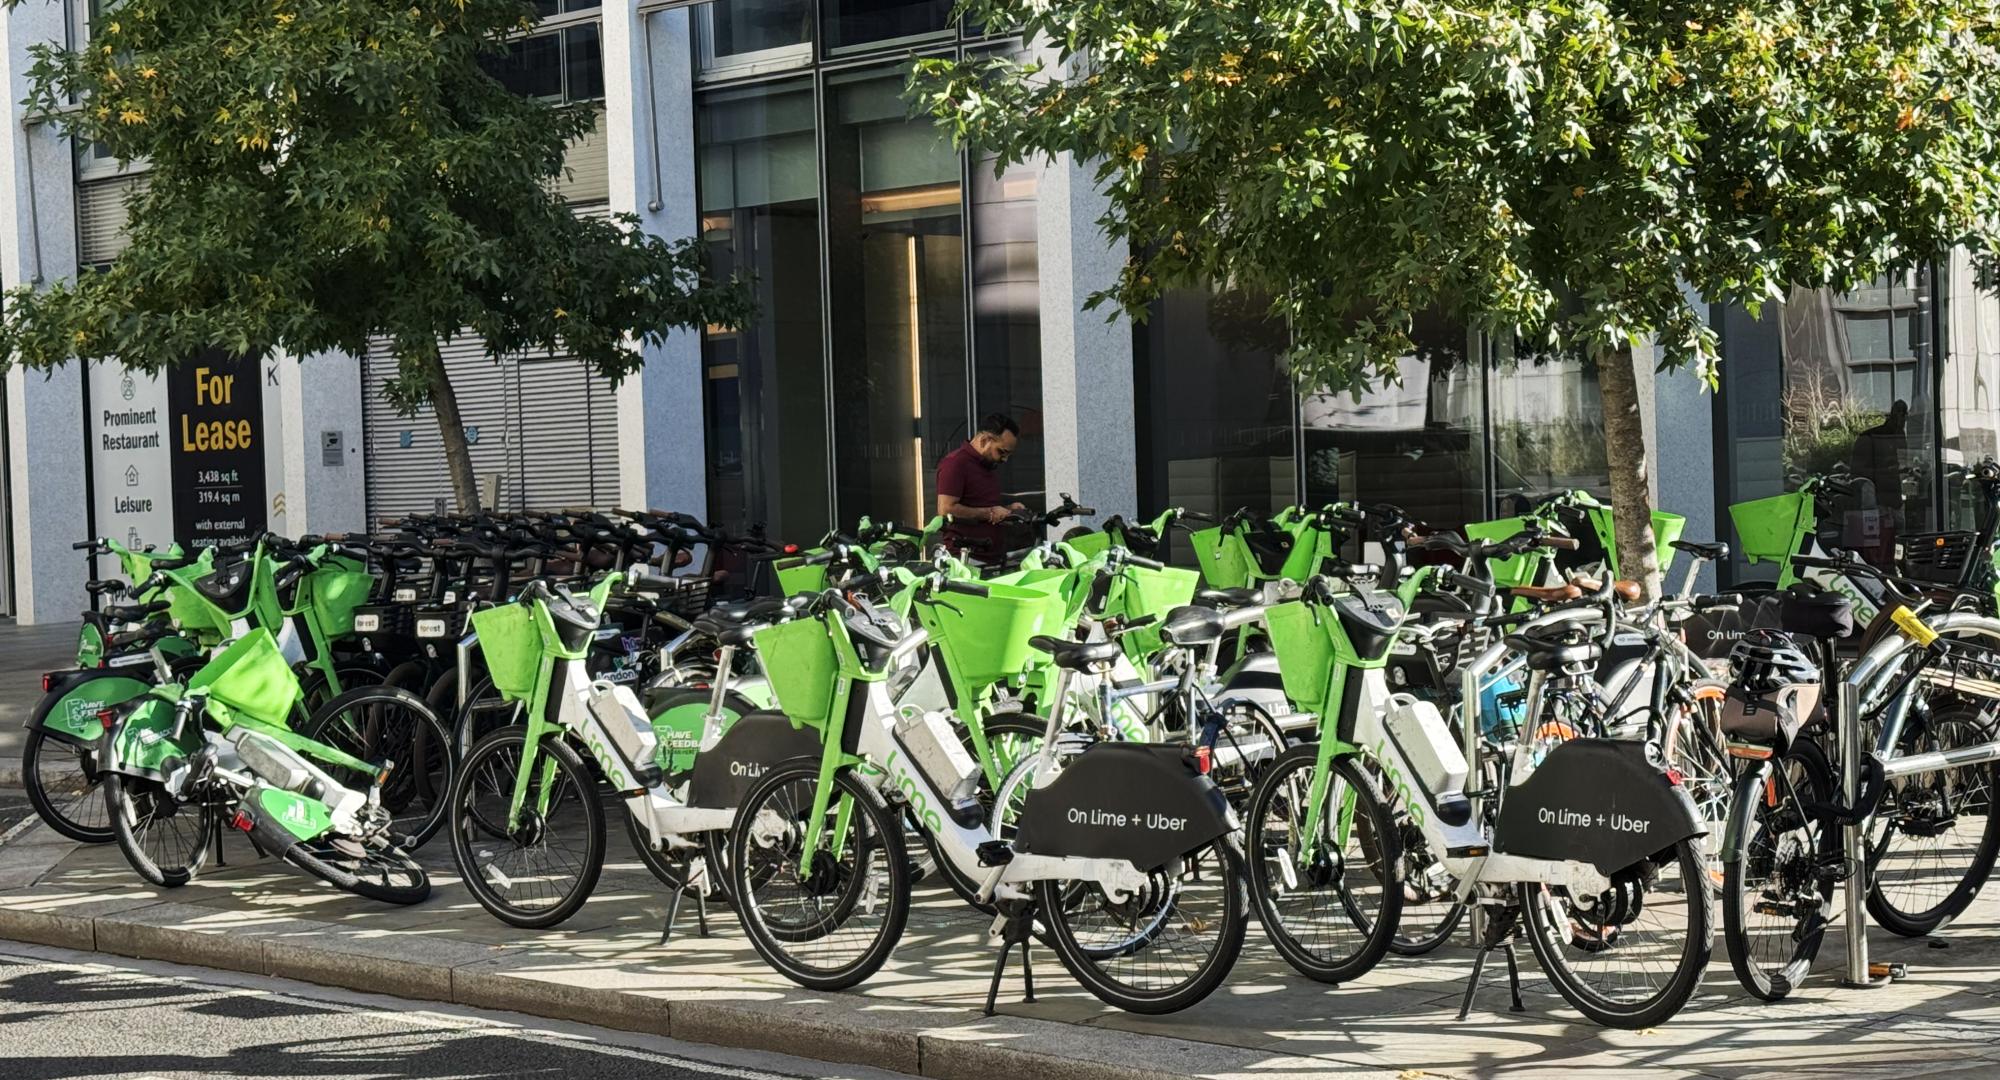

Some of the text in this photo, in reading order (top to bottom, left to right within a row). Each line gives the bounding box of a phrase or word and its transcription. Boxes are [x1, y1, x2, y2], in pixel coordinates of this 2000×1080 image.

[195, 367, 234, 406] For
[103, 407, 157, 427] Prominent
[102, 432, 160, 451] Restaurant
[181, 414, 252, 452] Lease
[198, 470, 220, 483] 3,438
[220, 473, 230, 484] sq
[114, 496, 153, 514] Leisure
[198, 491, 241, 505] 319.4 sq m
[195, 518, 246, 531] with external
[1706, 629, 1746, 641] On Lim
[666, 730, 693, 740] HAVE
[580, 718, 626, 790] Lime
[730, 760, 747, 776] On
[886, 749, 942, 834] Lime
[1376, 738, 1425, 829] Lime
[1067, 807, 1088, 825] On
[1090, 808, 1127, 828] Lime
[1146, 813, 1188, 832] Uber
[1538, 807, 1556, 825] On
[1558, 808, 1592, 828] Lime
[1610, 813, 1651, 834] Uber
